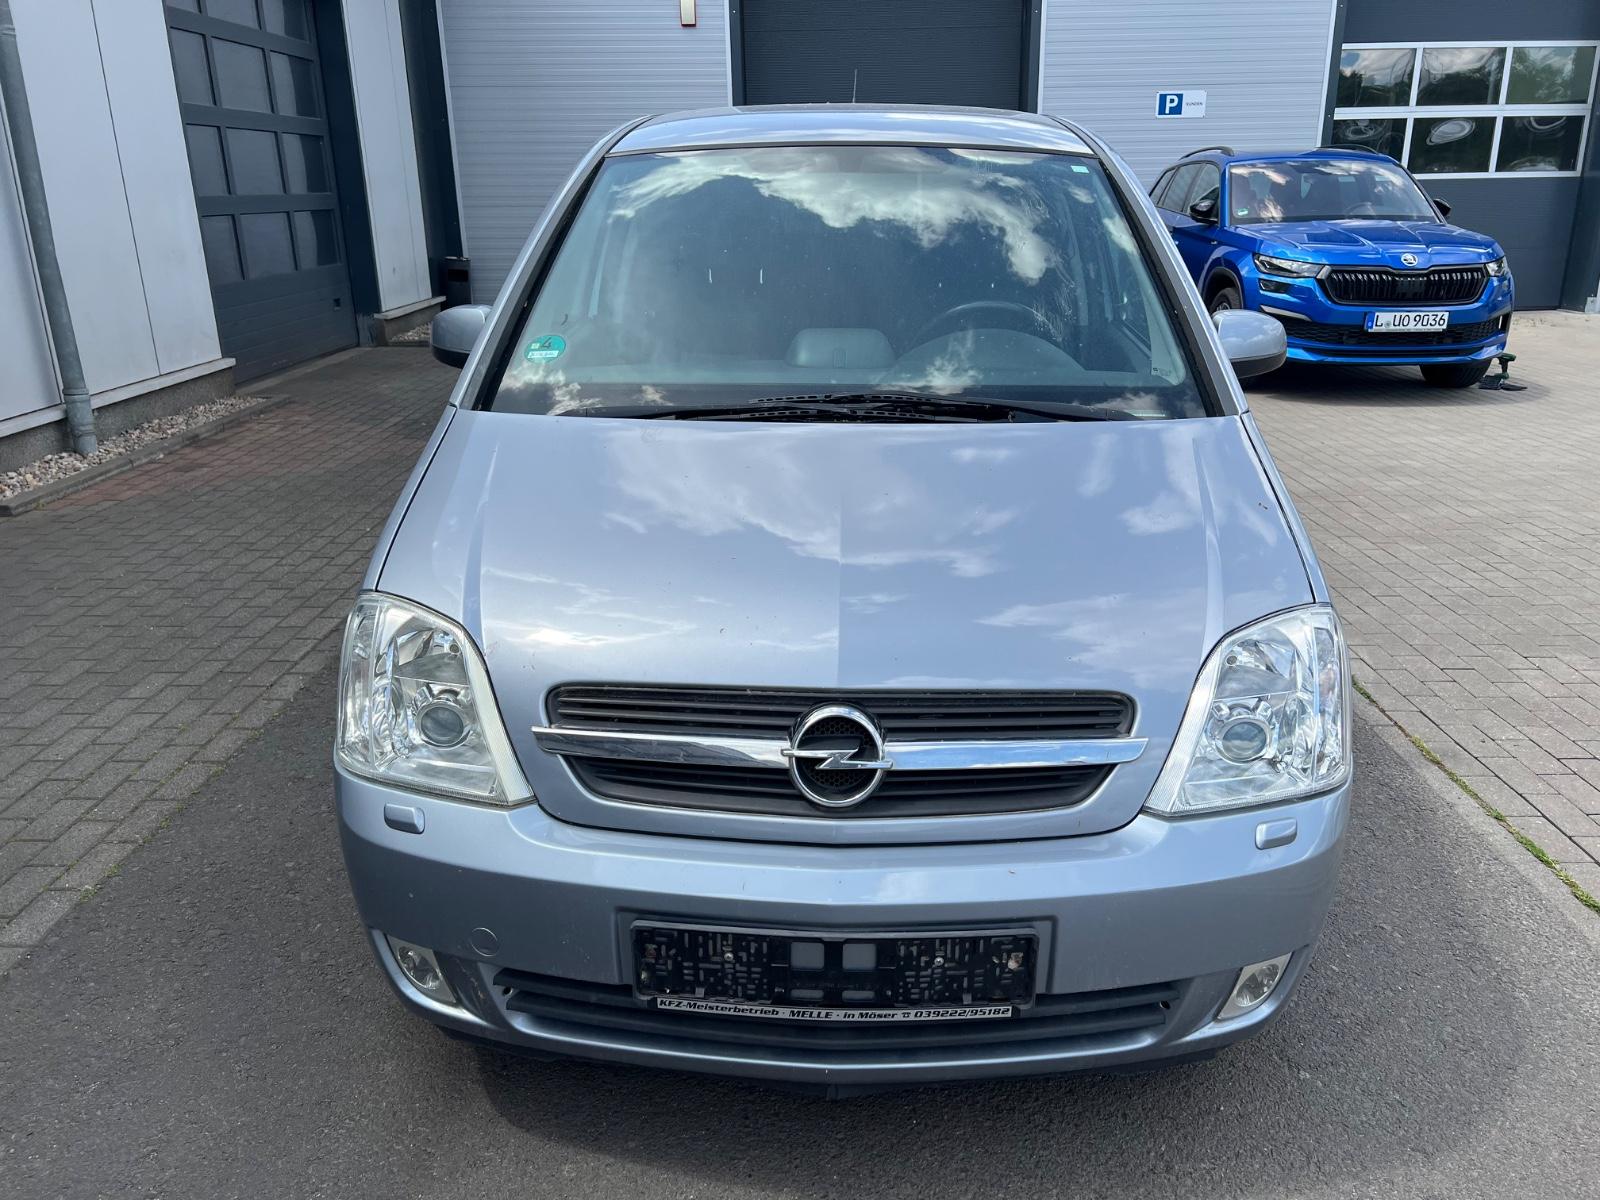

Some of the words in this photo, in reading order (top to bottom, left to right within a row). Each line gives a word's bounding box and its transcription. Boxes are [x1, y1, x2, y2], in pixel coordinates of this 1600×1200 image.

[1165, 95, 1179, 114] P
[1375, 314, 1383, 327] L
[1393, 314, 1410, 327] UO
[1413, 313, 1446, 327] 9036
[541, 336, 552, 348] 4
[659, 1000, 779, 1016] KFZ-Meisterbetrieb
[788, 1010, 833, 1019] MELLE
[857, 1011, 897, 1019] Möser
[914, 1007, 1010, 1018] 039222/95182
